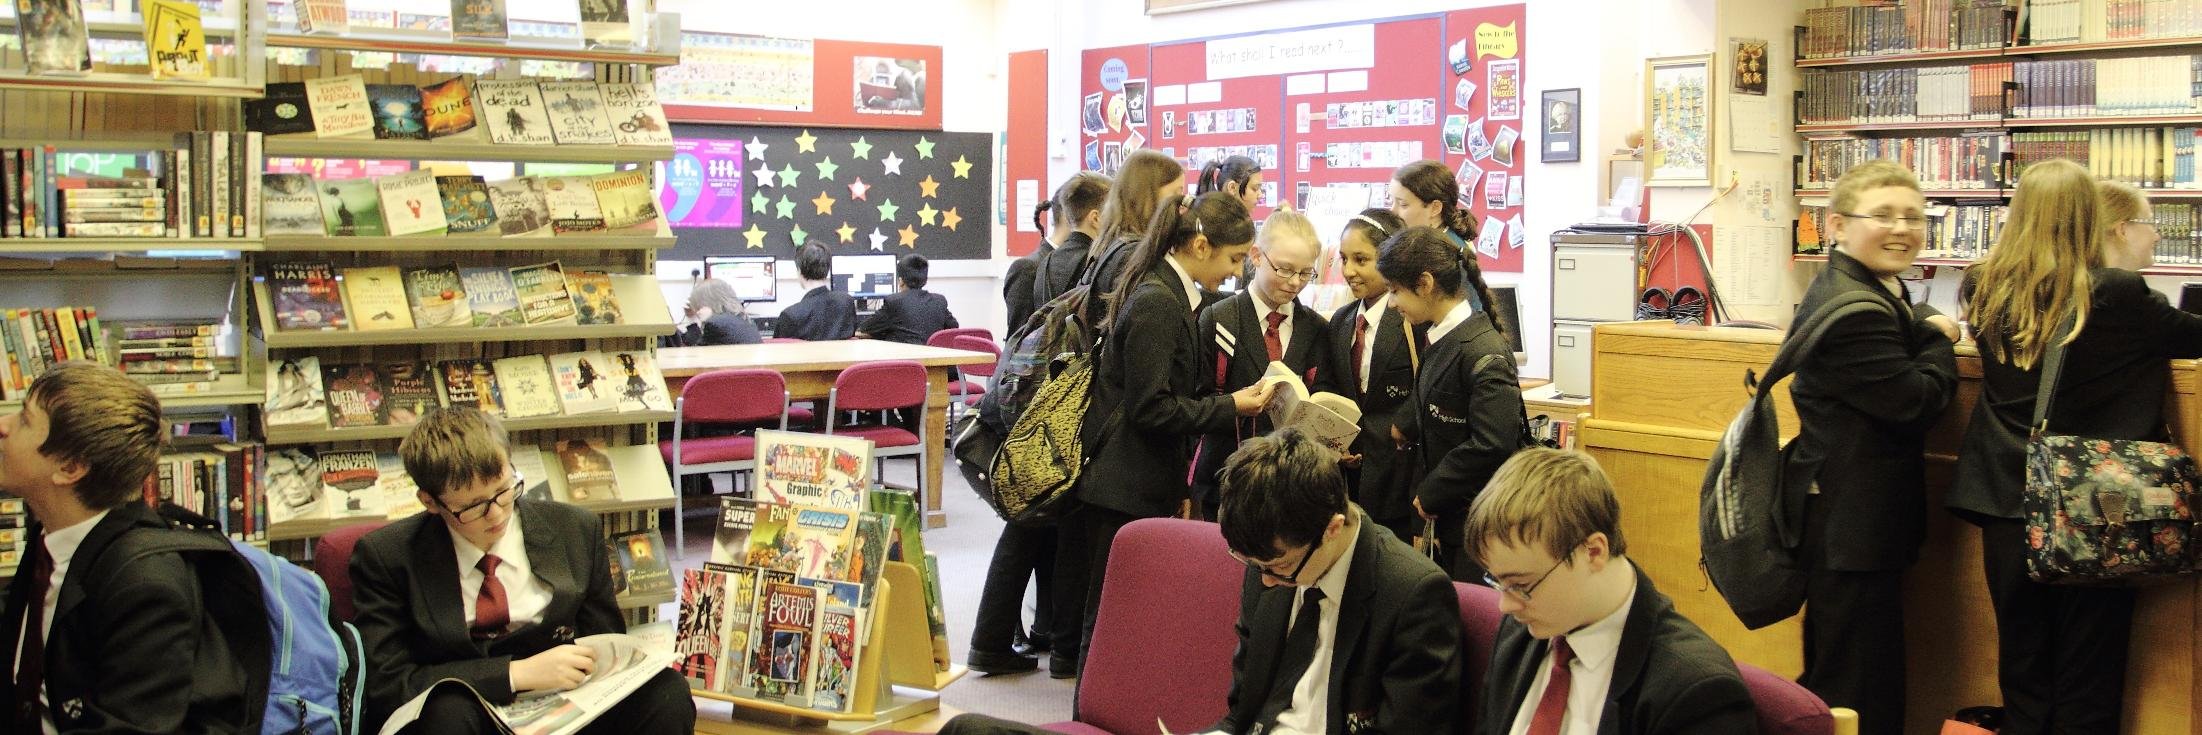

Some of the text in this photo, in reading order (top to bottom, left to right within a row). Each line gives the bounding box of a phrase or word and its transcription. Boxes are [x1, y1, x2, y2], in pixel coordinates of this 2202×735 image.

[1210, 51, 1237, 64] What
[1241, 47, 1264, 62] shall
[1268, 45, 1276, 60] I
[1280, 41, 1304, 58] read
[1308, 43, 1332, 56] next
[479, 80, 537, 89] procession
[316, 92, 361, 102] FRENCH
[486, 94, 530, 106] dead
[423, 96, 471, 116] DUNE
[595, 174, 644, 190] DOMINION
[450, 218, 491, 229] SNUFF
[274, 270, 331, 280] HARRIS
[410, 270, 455, 281] Time's
[394, 379, 423, 388] Purple
[391, 386, 432, 394] Hibiscus
[330, 390, 359, 406] QUEEN
[1449, 415, 1467, 424] School
[323, 460, 374, 472] FRANZEN
[775, 455, 817, 475] MARVEL
[787, 483, 822, 497] Graphic
[724, 509, 755, 523] SUPER
[769, 591, 814, 611] ARTEMIS
[769, 605, 812, 627] FOWL
